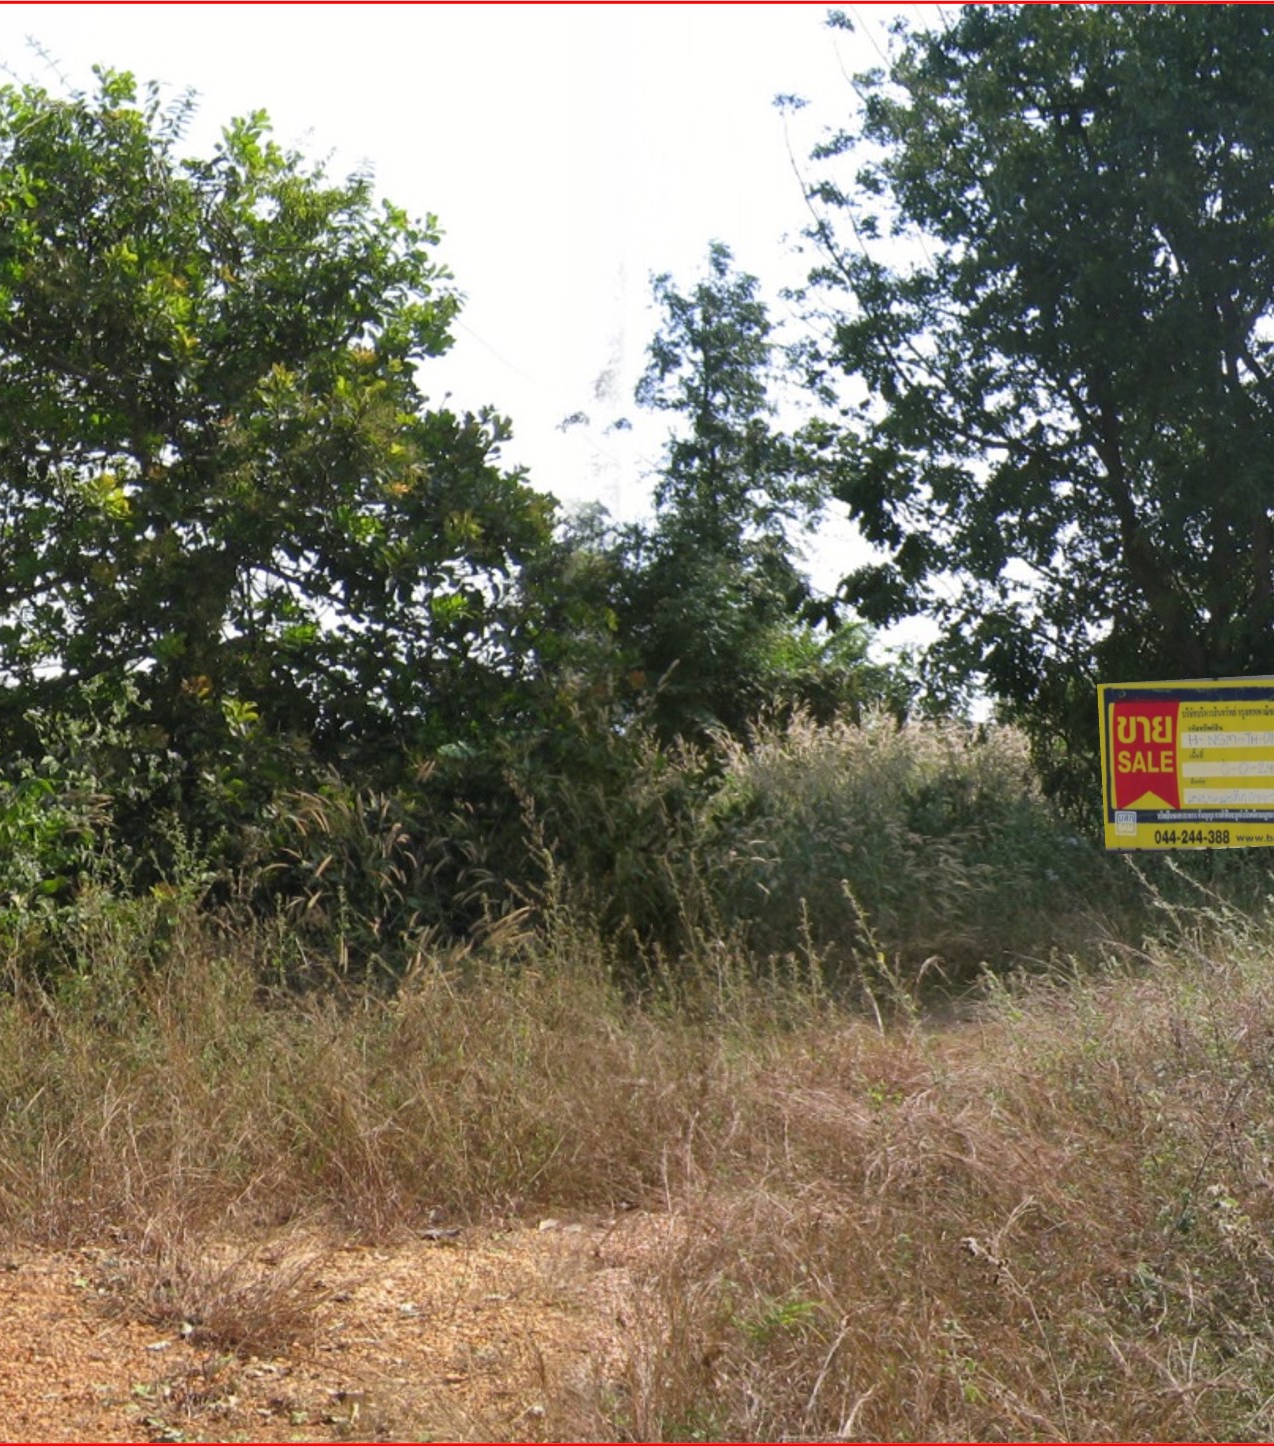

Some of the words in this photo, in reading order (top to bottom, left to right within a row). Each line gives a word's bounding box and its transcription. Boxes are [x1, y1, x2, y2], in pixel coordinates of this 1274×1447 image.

[1117, 715, 1173, 744] ขาย
[1118, 750, 1174, 773] SALE
[1154, 829, 1230, 845] 044-244-388
